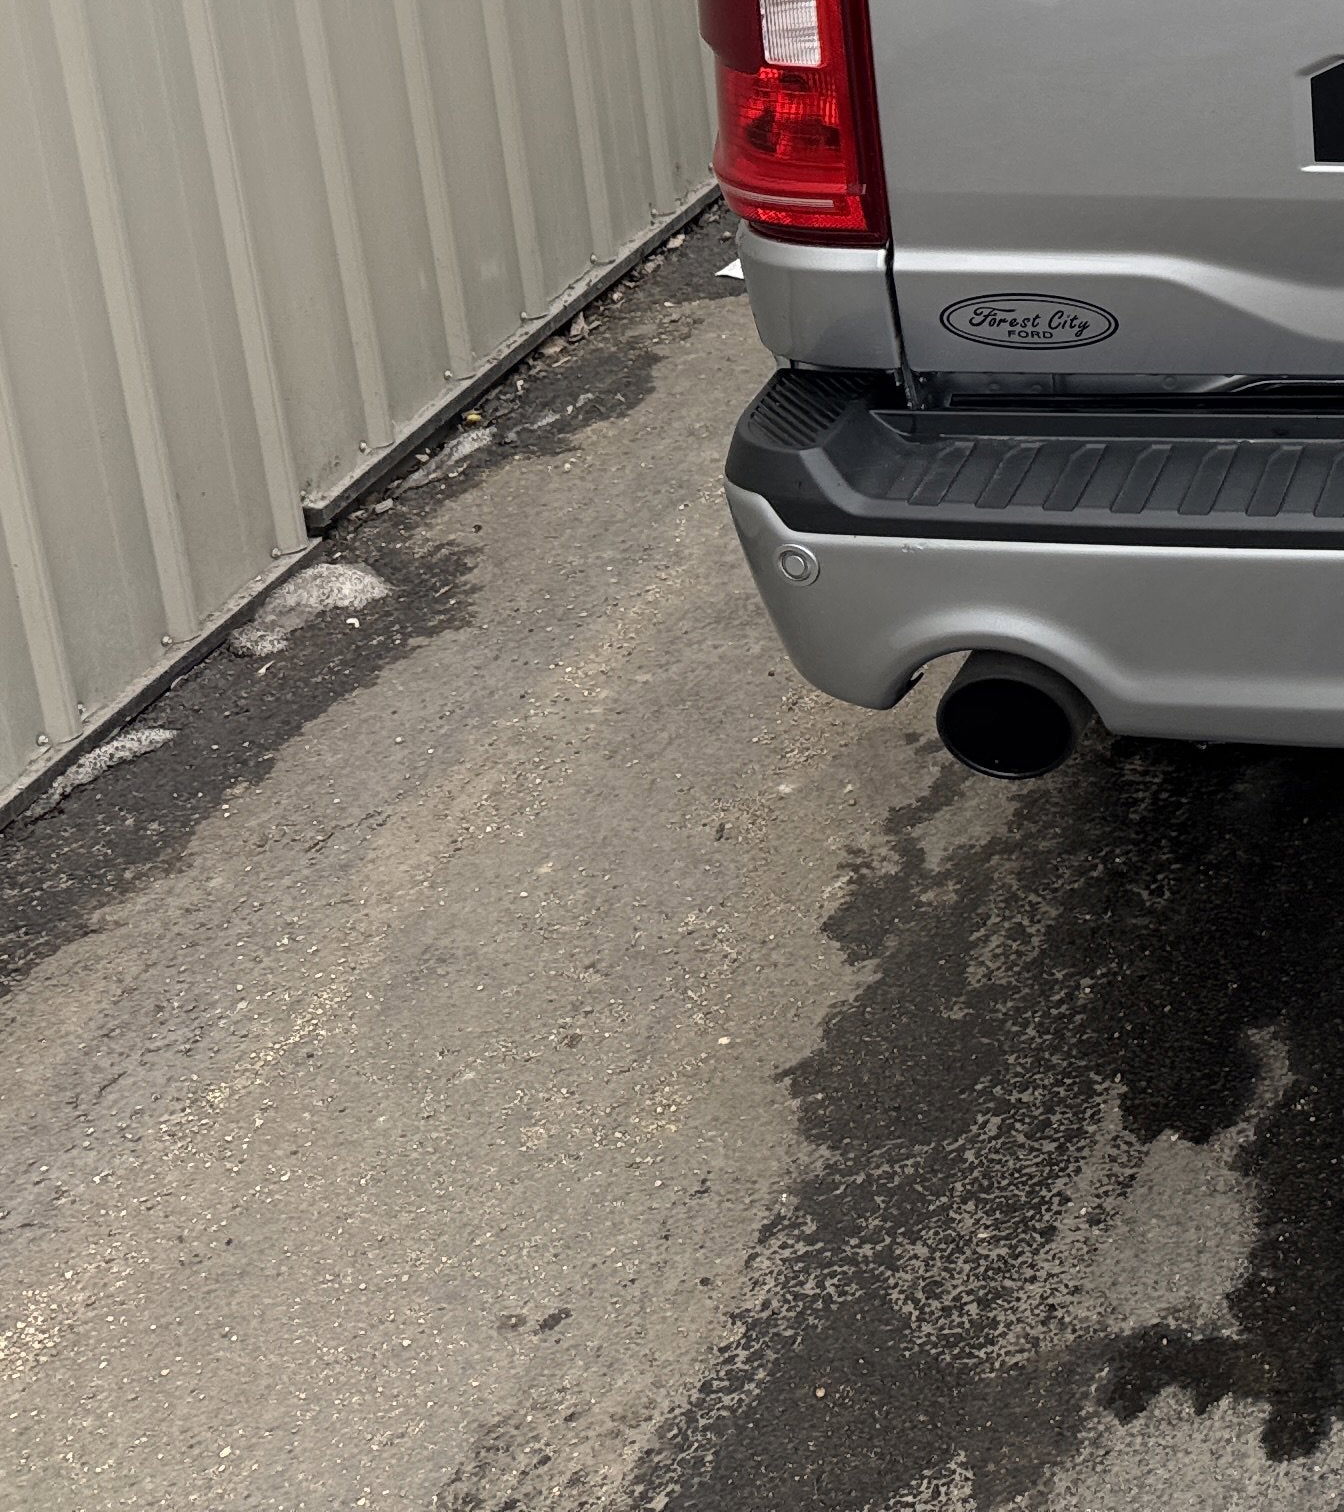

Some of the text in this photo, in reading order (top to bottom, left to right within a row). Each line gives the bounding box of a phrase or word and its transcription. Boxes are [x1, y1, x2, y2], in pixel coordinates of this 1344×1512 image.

[968, 306, 1091, 338] Forest City
[1007, 329, 1054, 339] FORD
